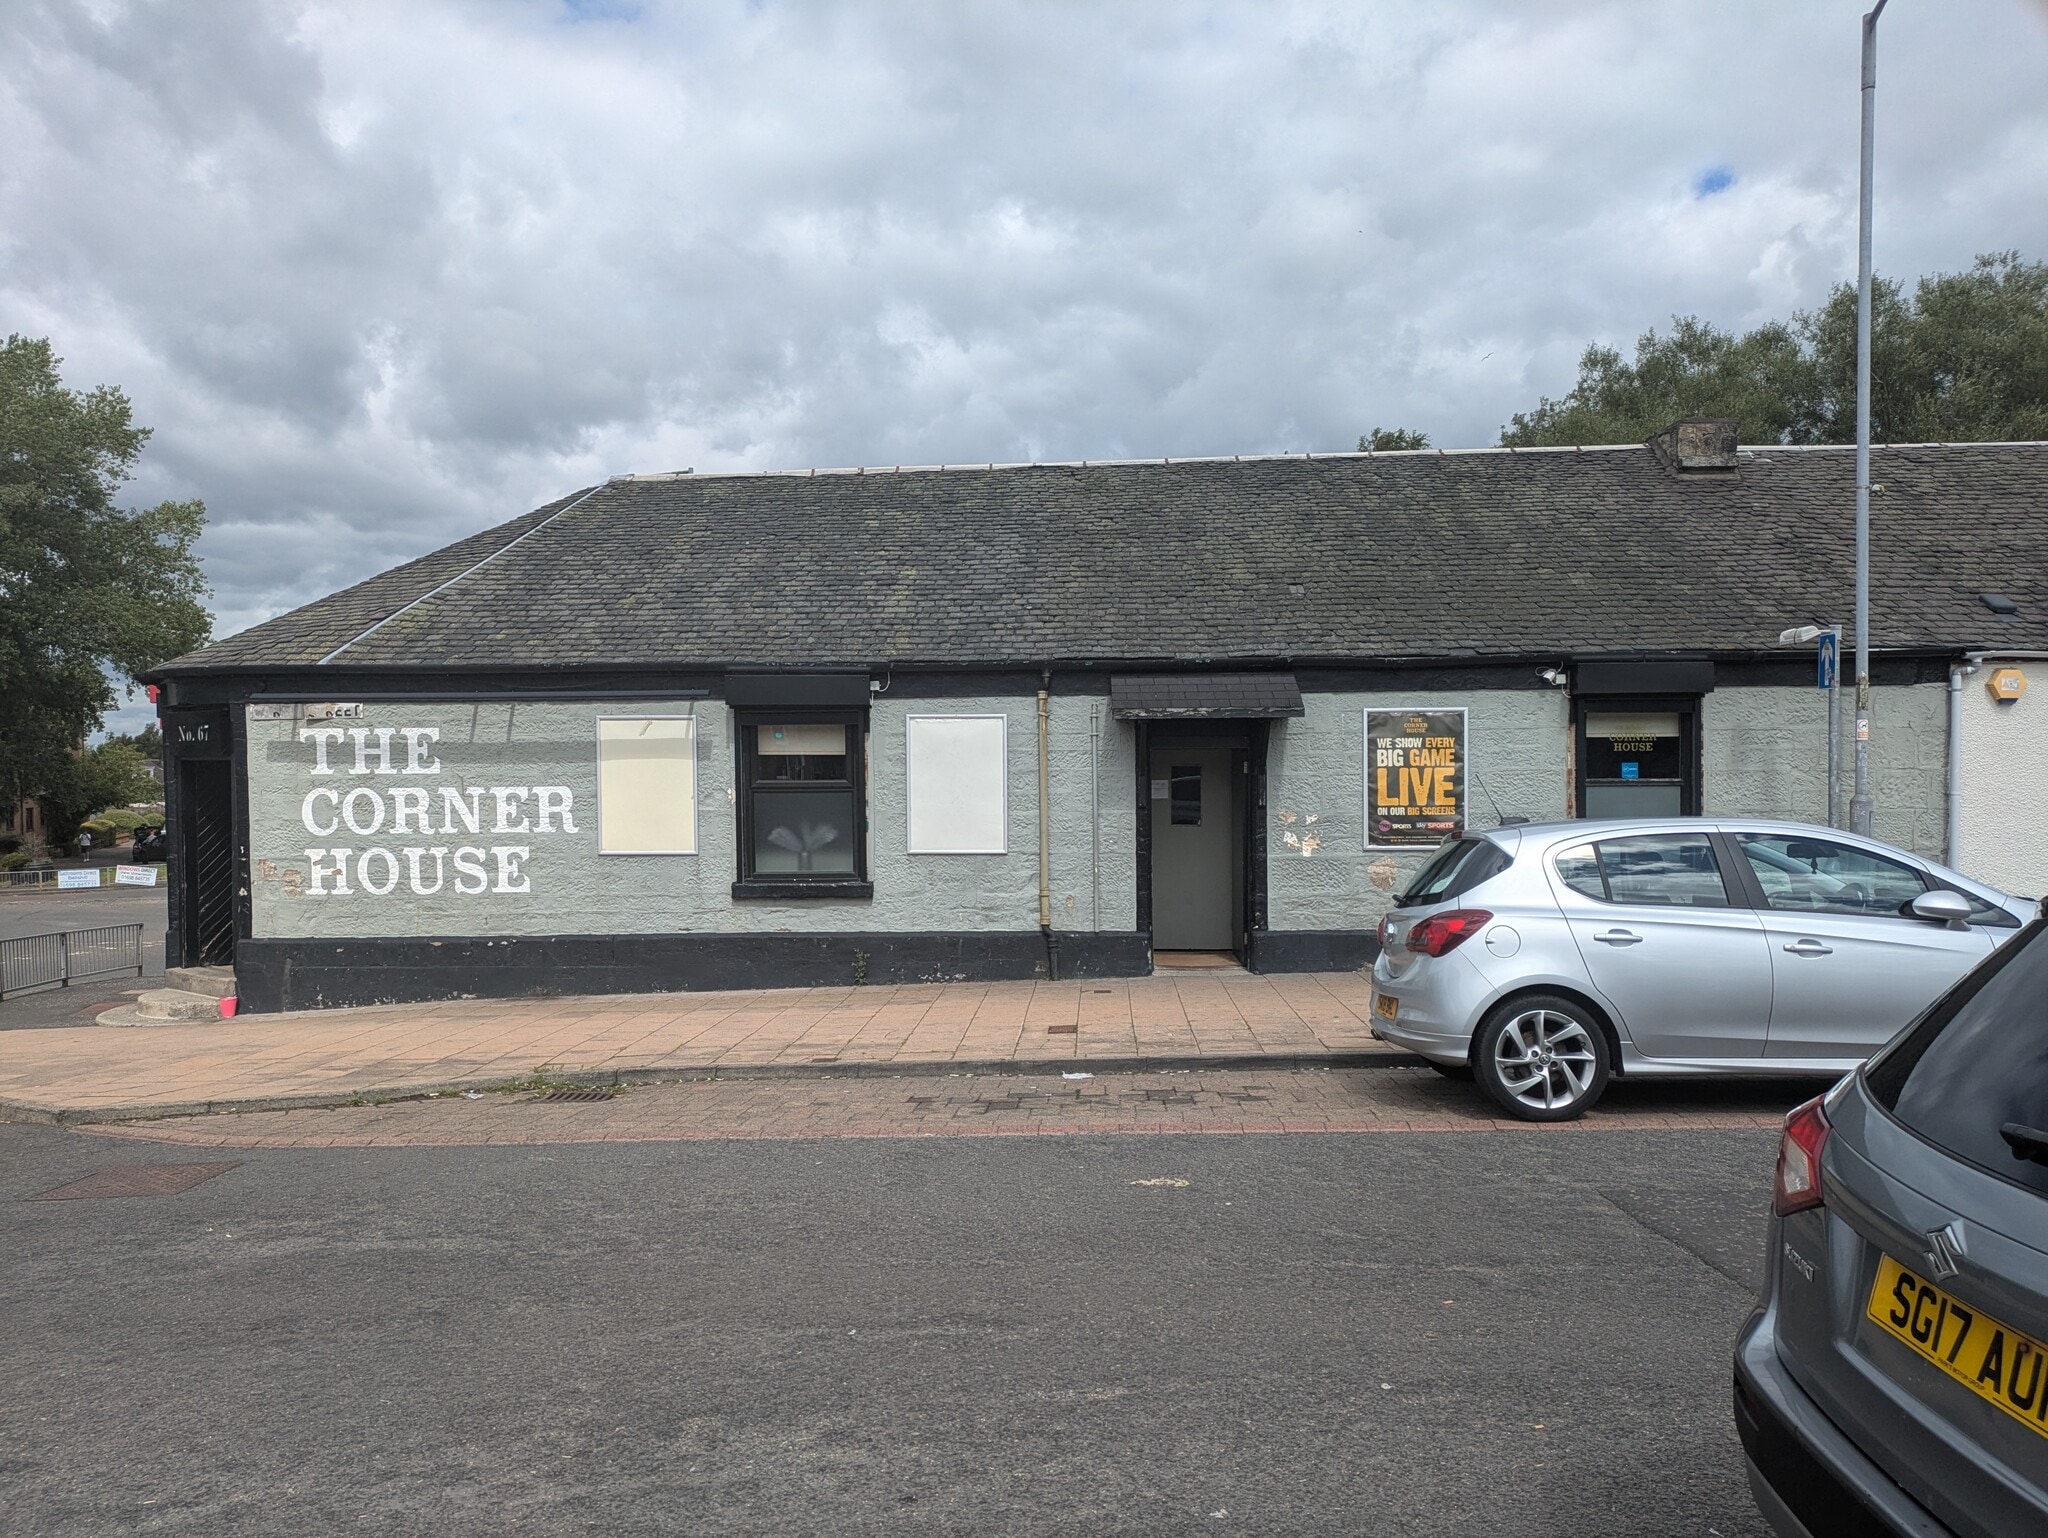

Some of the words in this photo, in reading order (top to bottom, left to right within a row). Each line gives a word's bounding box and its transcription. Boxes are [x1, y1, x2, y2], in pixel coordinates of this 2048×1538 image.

[178, 725, 195, 742] No.
[197, 724, 209, 742] 67
[1377, 738, 1392, 748] WE
[1395, 737, 1423, 748] SHOW
[1425, 736, 1456, 748] EVERY
[1609, 732, 1656, 741] CORNER
[1613, 743, 1653, 751] HOUSE
[300, 727, 441, 775] THE
[1377, 749, 1403, 767] BIG
[1409, 748, 1456, 767] GAME
[1377, 767, 1456, 806] LIVE
[301, 785, 580, 836] CORNER
[1377, 806, 1388, 816] ON
[1389, 806, 1406, 816] OUR
[1407, 806, 1420, 816] BIG
[1422, 807, 1456, 815] SCREENS
[303, 845, 532, 896] HOUSE
[1783, 1242, 1813, 1283] SUZUKI
[1889, 1272, 1973, 1364] SG17
